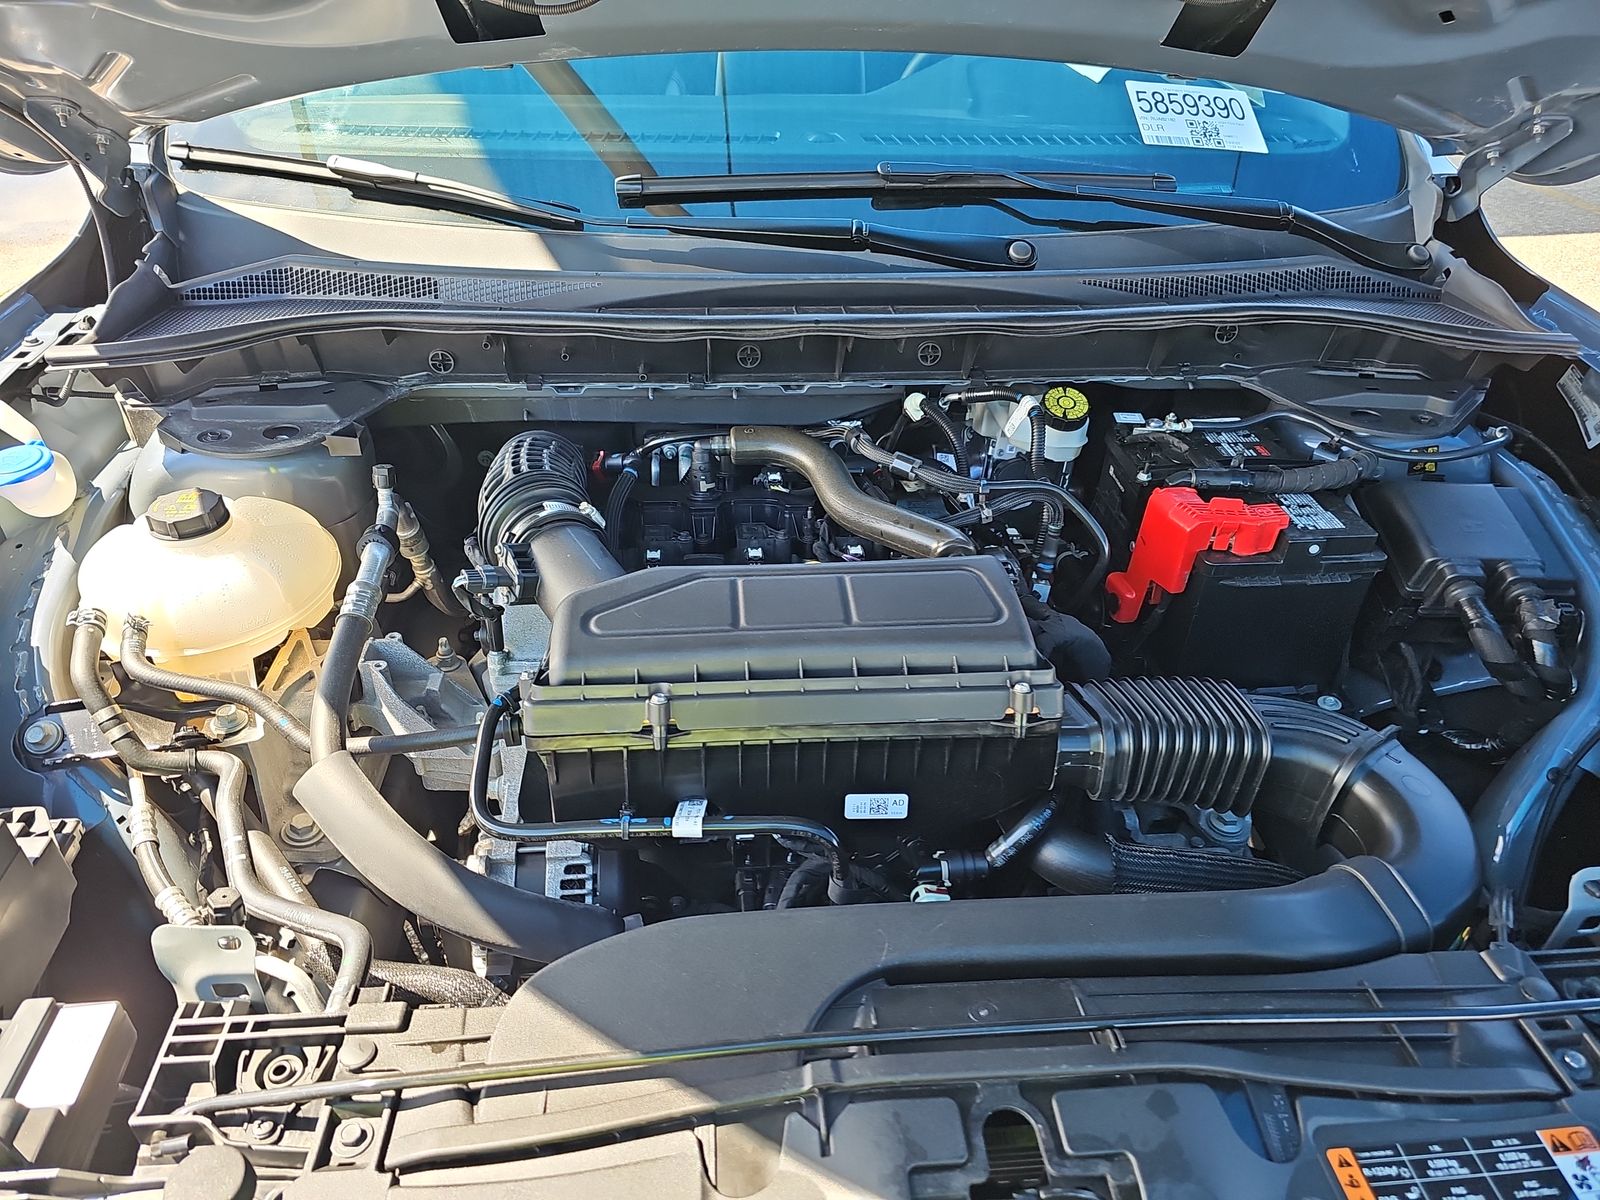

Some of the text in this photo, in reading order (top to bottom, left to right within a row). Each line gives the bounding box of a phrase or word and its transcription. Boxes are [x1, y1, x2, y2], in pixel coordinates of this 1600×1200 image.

[1136, 90, 1246, 121] 5859390
[1142, 123, 1166, 132] DLR
[892, 799, 905, 807] AD
